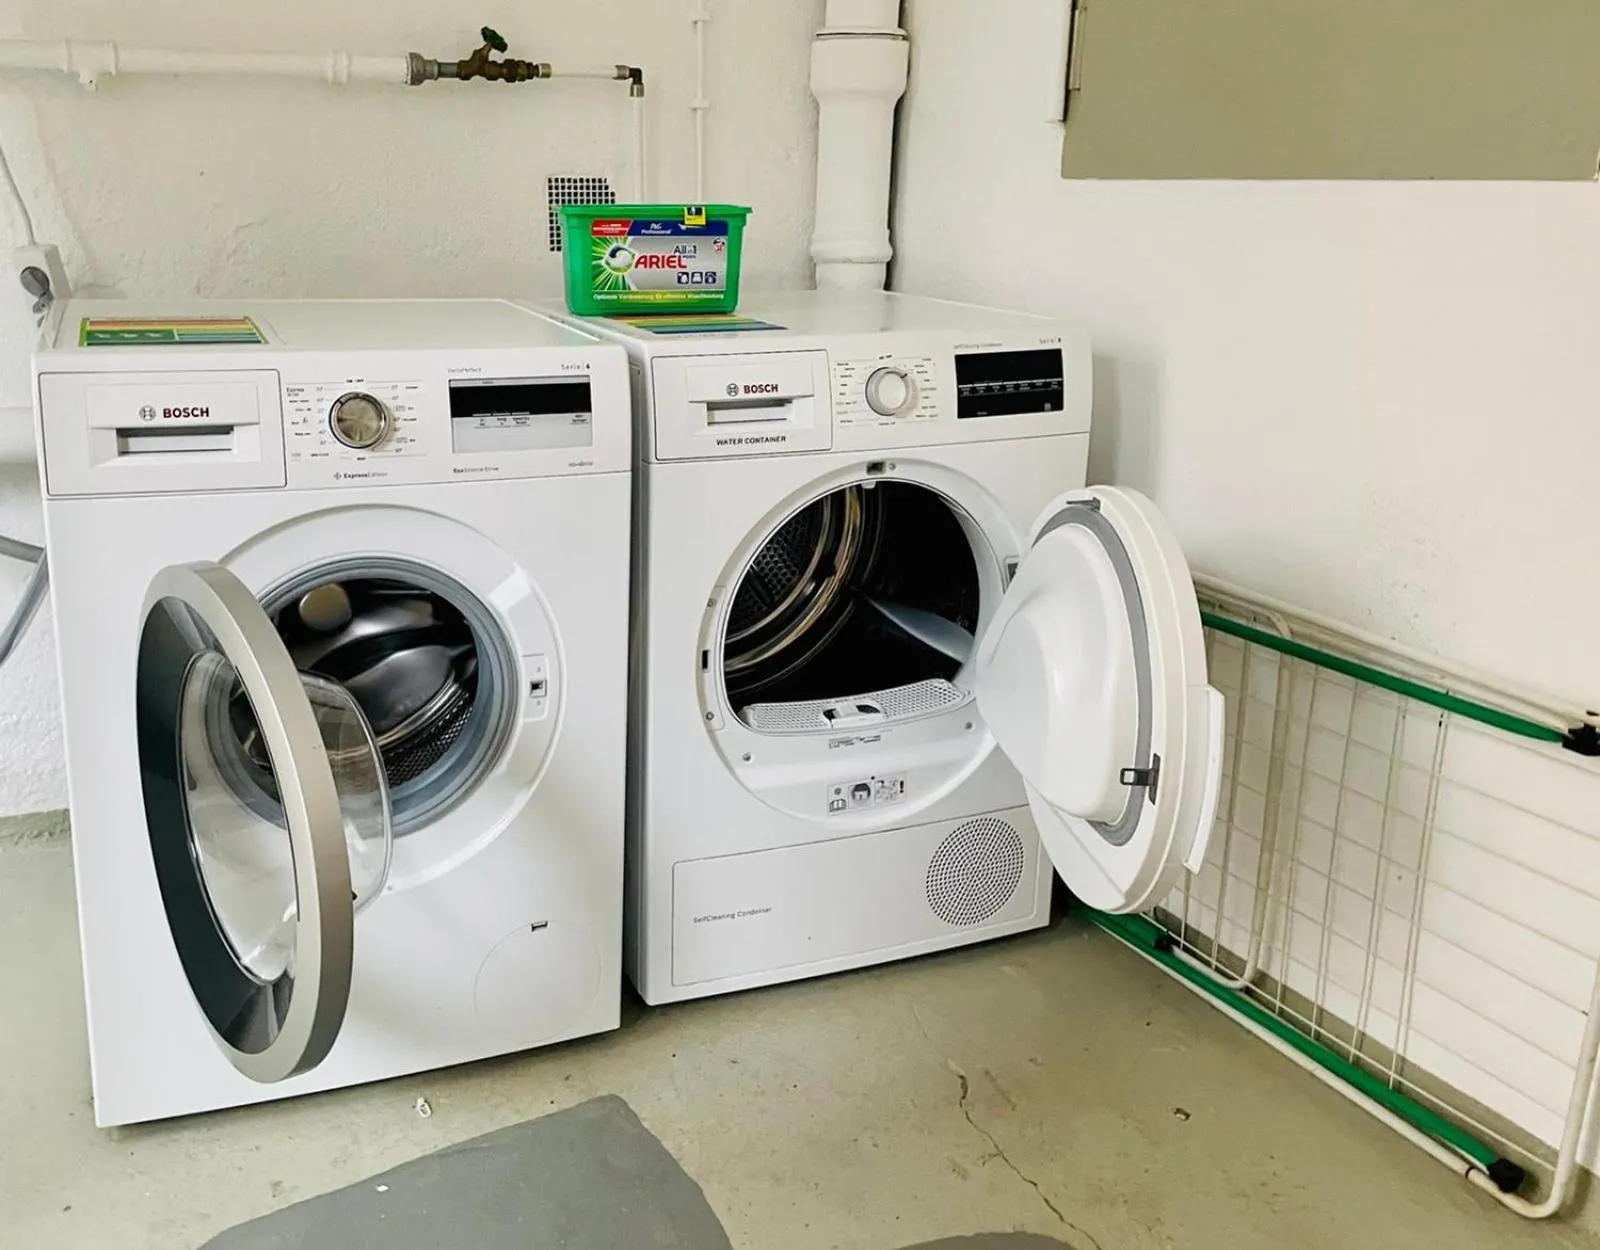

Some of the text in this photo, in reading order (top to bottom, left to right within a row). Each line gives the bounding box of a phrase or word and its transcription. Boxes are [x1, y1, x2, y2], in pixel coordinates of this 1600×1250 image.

[634, 254, 688, 269] ARIEL
[743, 384, 779, 395] BOSCH
[162, 407, 210, 419] BOSCH
[716, 435, 786, 446] WATER CONTAINER
